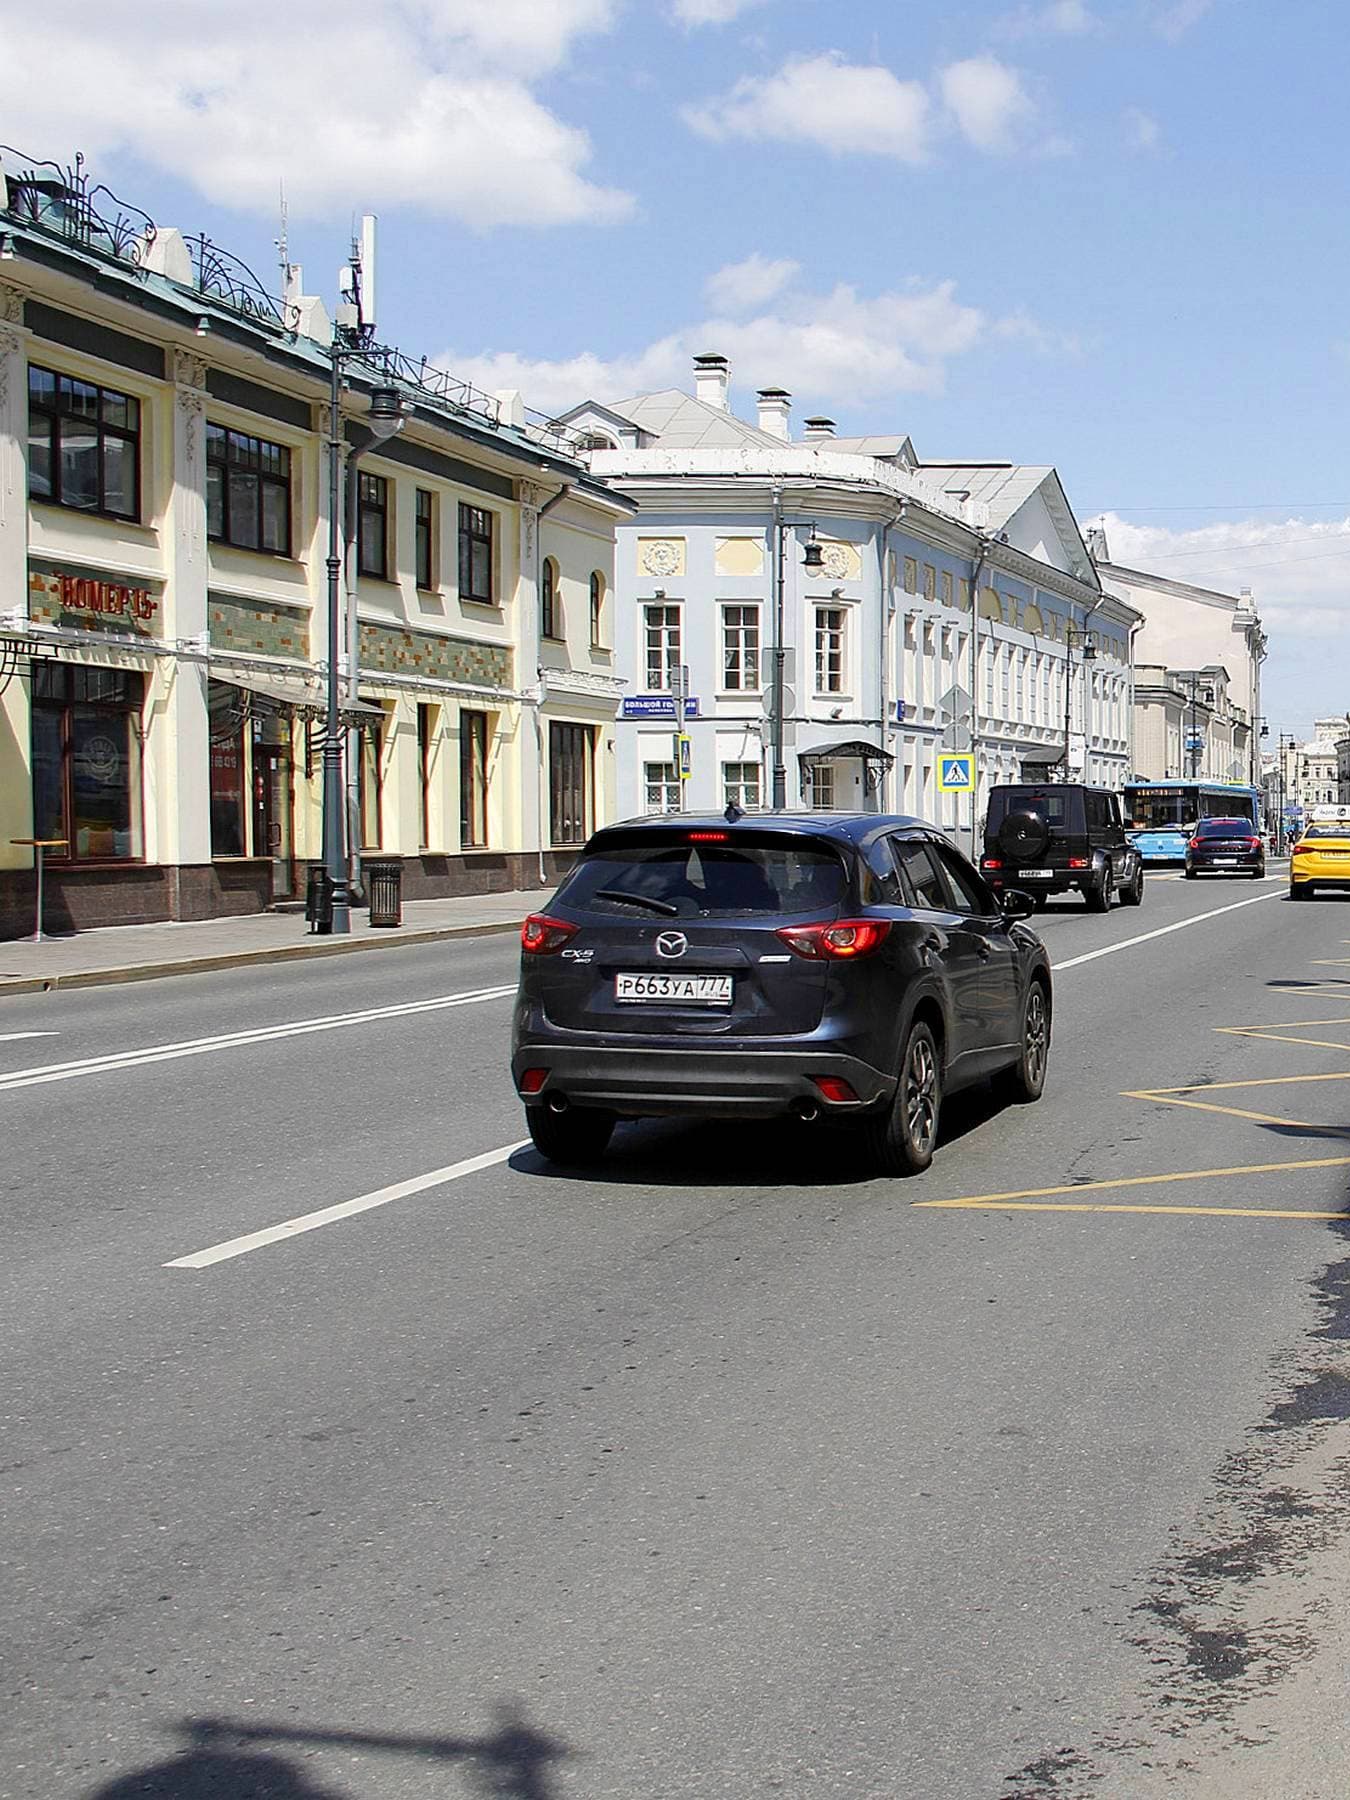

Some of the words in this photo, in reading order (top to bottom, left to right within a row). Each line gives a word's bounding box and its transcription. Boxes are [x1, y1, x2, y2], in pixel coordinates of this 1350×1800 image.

[61, 575, 128, 614] НОМЕР
[561, 949, 595, 958] CX-5
[622, 975, 695, 996] Р663УА
[699, 975, 727, 991] 777
